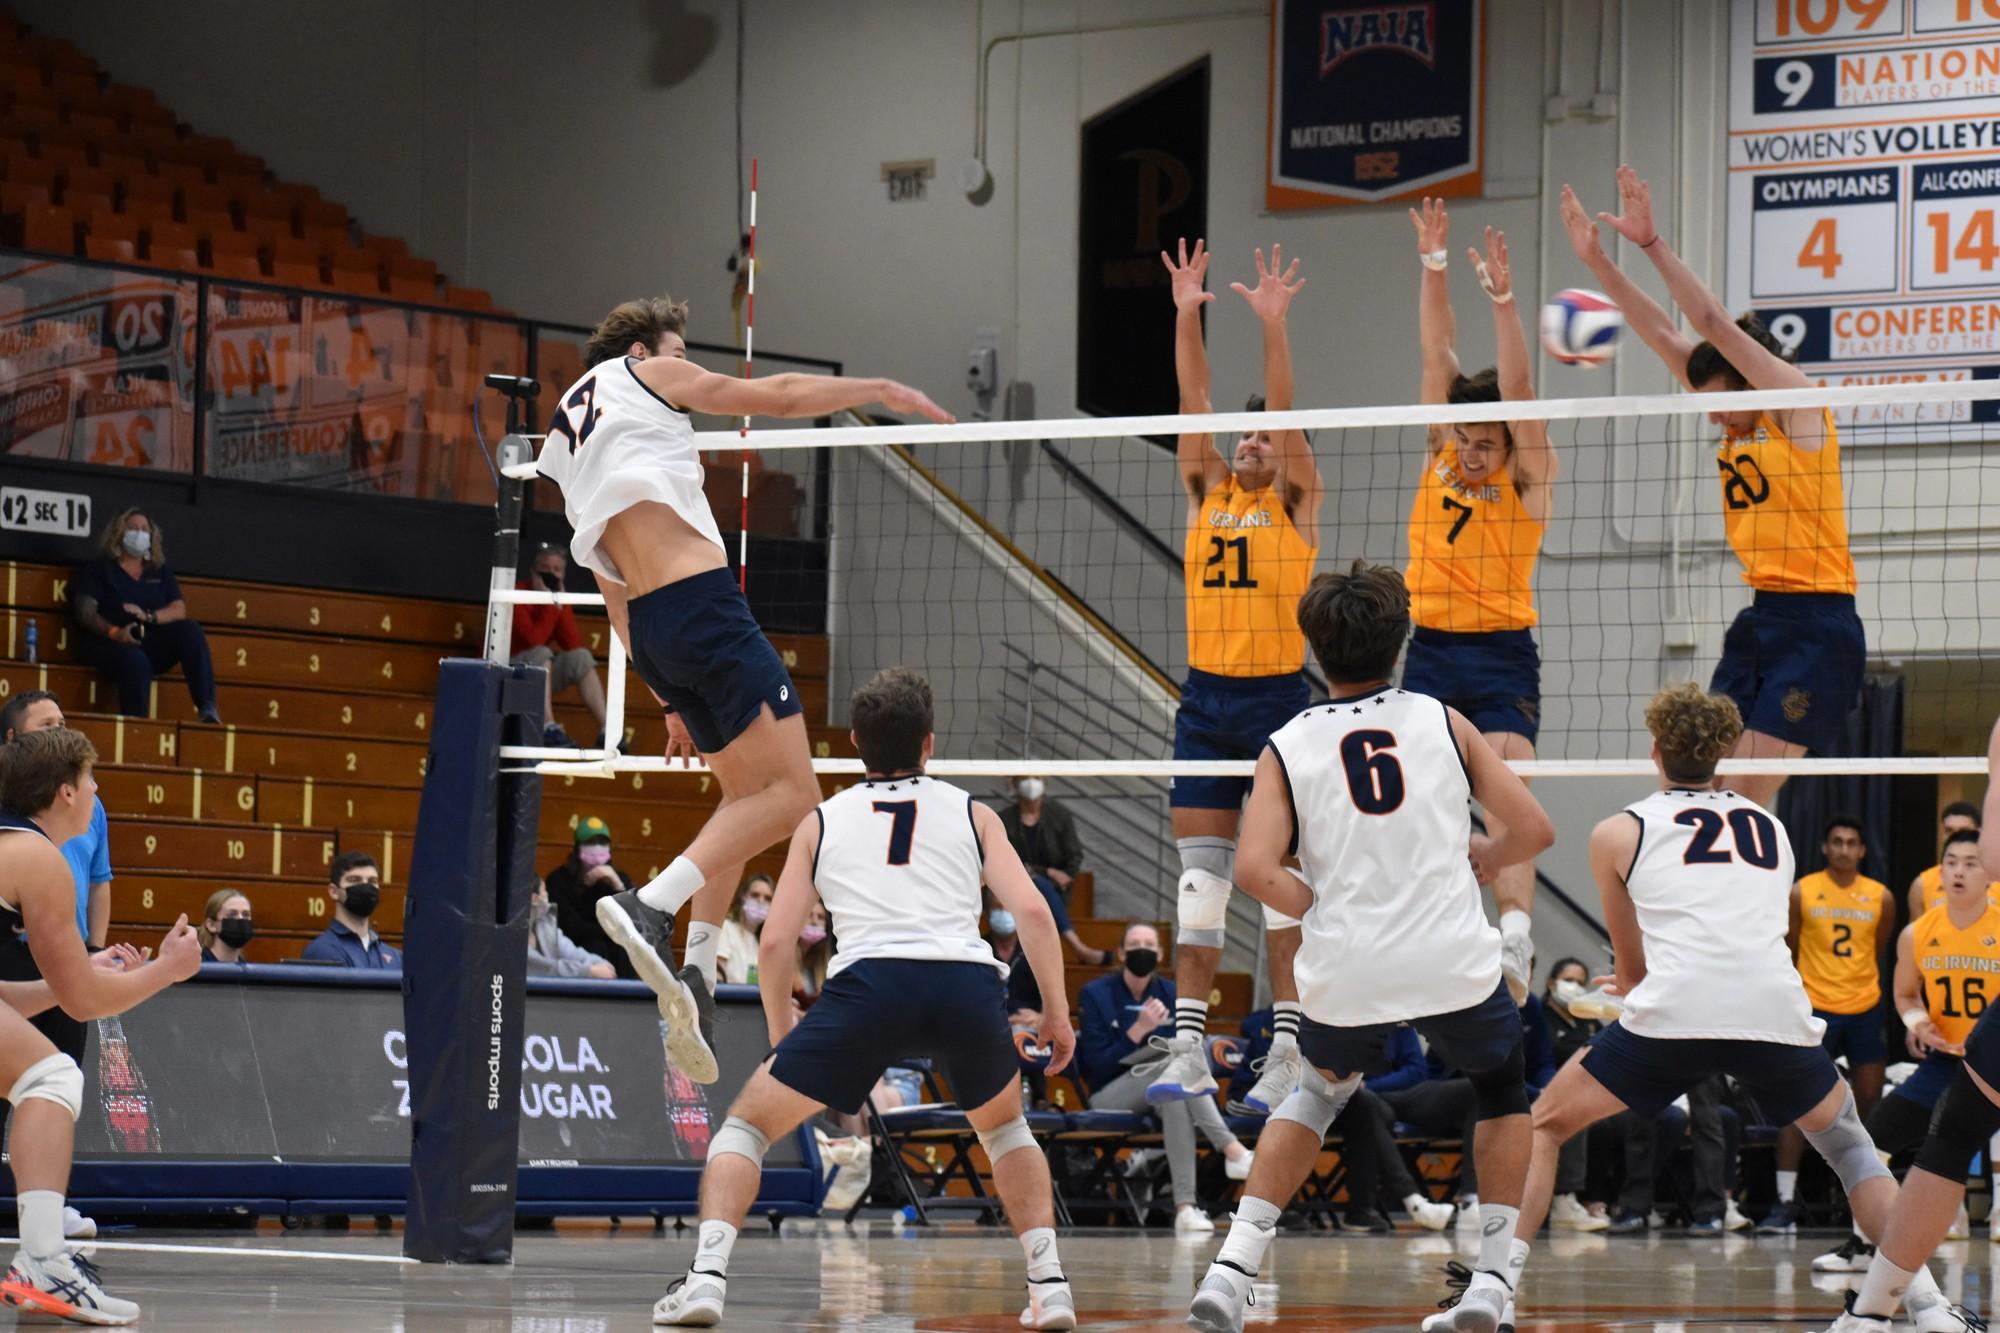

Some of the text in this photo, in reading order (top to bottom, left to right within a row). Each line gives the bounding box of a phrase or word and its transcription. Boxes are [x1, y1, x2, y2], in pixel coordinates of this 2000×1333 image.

[1319, 4, 1435, 78] NAIA
[1774, 60, 1814, 107] 9
[1842, 79, 1996, 104] PLAYERS OF THE
[1290, 115, 1462, 149] NATIONAL CHAMPIONS
[1743, 130, 1866, 162] WOMEN'S
[1762, 174, 1890, 202] OLYMPIANS
[1797, 218, 1842, 279] 4
[1927, 209, 2000, 274] 14
[1770, 314, 1807, 357] 9
[1838, 334, 1993, 355] PLAYERS OF THE
[1717, 454, 1770, 510] 20
[15, 495, 75, 530] 2 SEC 1
[1442, 495, 1473, 545] 7
[1203, 536, 1258, 588] 21
[53, 579, 67, 602] K
[57, 628, 66, 650] J
[236, 601, 247, 619] 2
[310, 607, 320, 625] 3
[381, 616, 391, 632] 4
[454, 622, 463, 639] 5
[591, 633, 600, 649] 7
[236, 648, 392, 679] 2 3 4
[269, 701, 279, 718] 2
[342, 706, 352, 724] 3
[415, 713, 426, 730] 4
[159, 733, 175, 756] H
[269, 748, 276, 766] 1
[346, 753, 356, 771] 2
[632, 773, 643, 790] 6
[700, 776, 711, 793] 7
[1339, 729, 1405, 816] 6
[147, 785, 164, 804] 10
[238, 786, 254, 810] G
[347, 800, 353, 817] 1
[642, 819, 652, 835] 5
[872, 799, 917, 866] 7
[145, 835, 245, 860] 9 10
[323, 842, 334, 865] F
[1673, 808, 1779, 871] 20
[143, 889, 325, 917] 8 10
[1832, 923, 1852, 958] 2
[1922, 955, 2000, 973] UC IRVINE
[1935, 976, 1988, 1019] 16
[487, 974, 503, 1110] sports imports
[1056, 1089, 1065, 1106] 5
